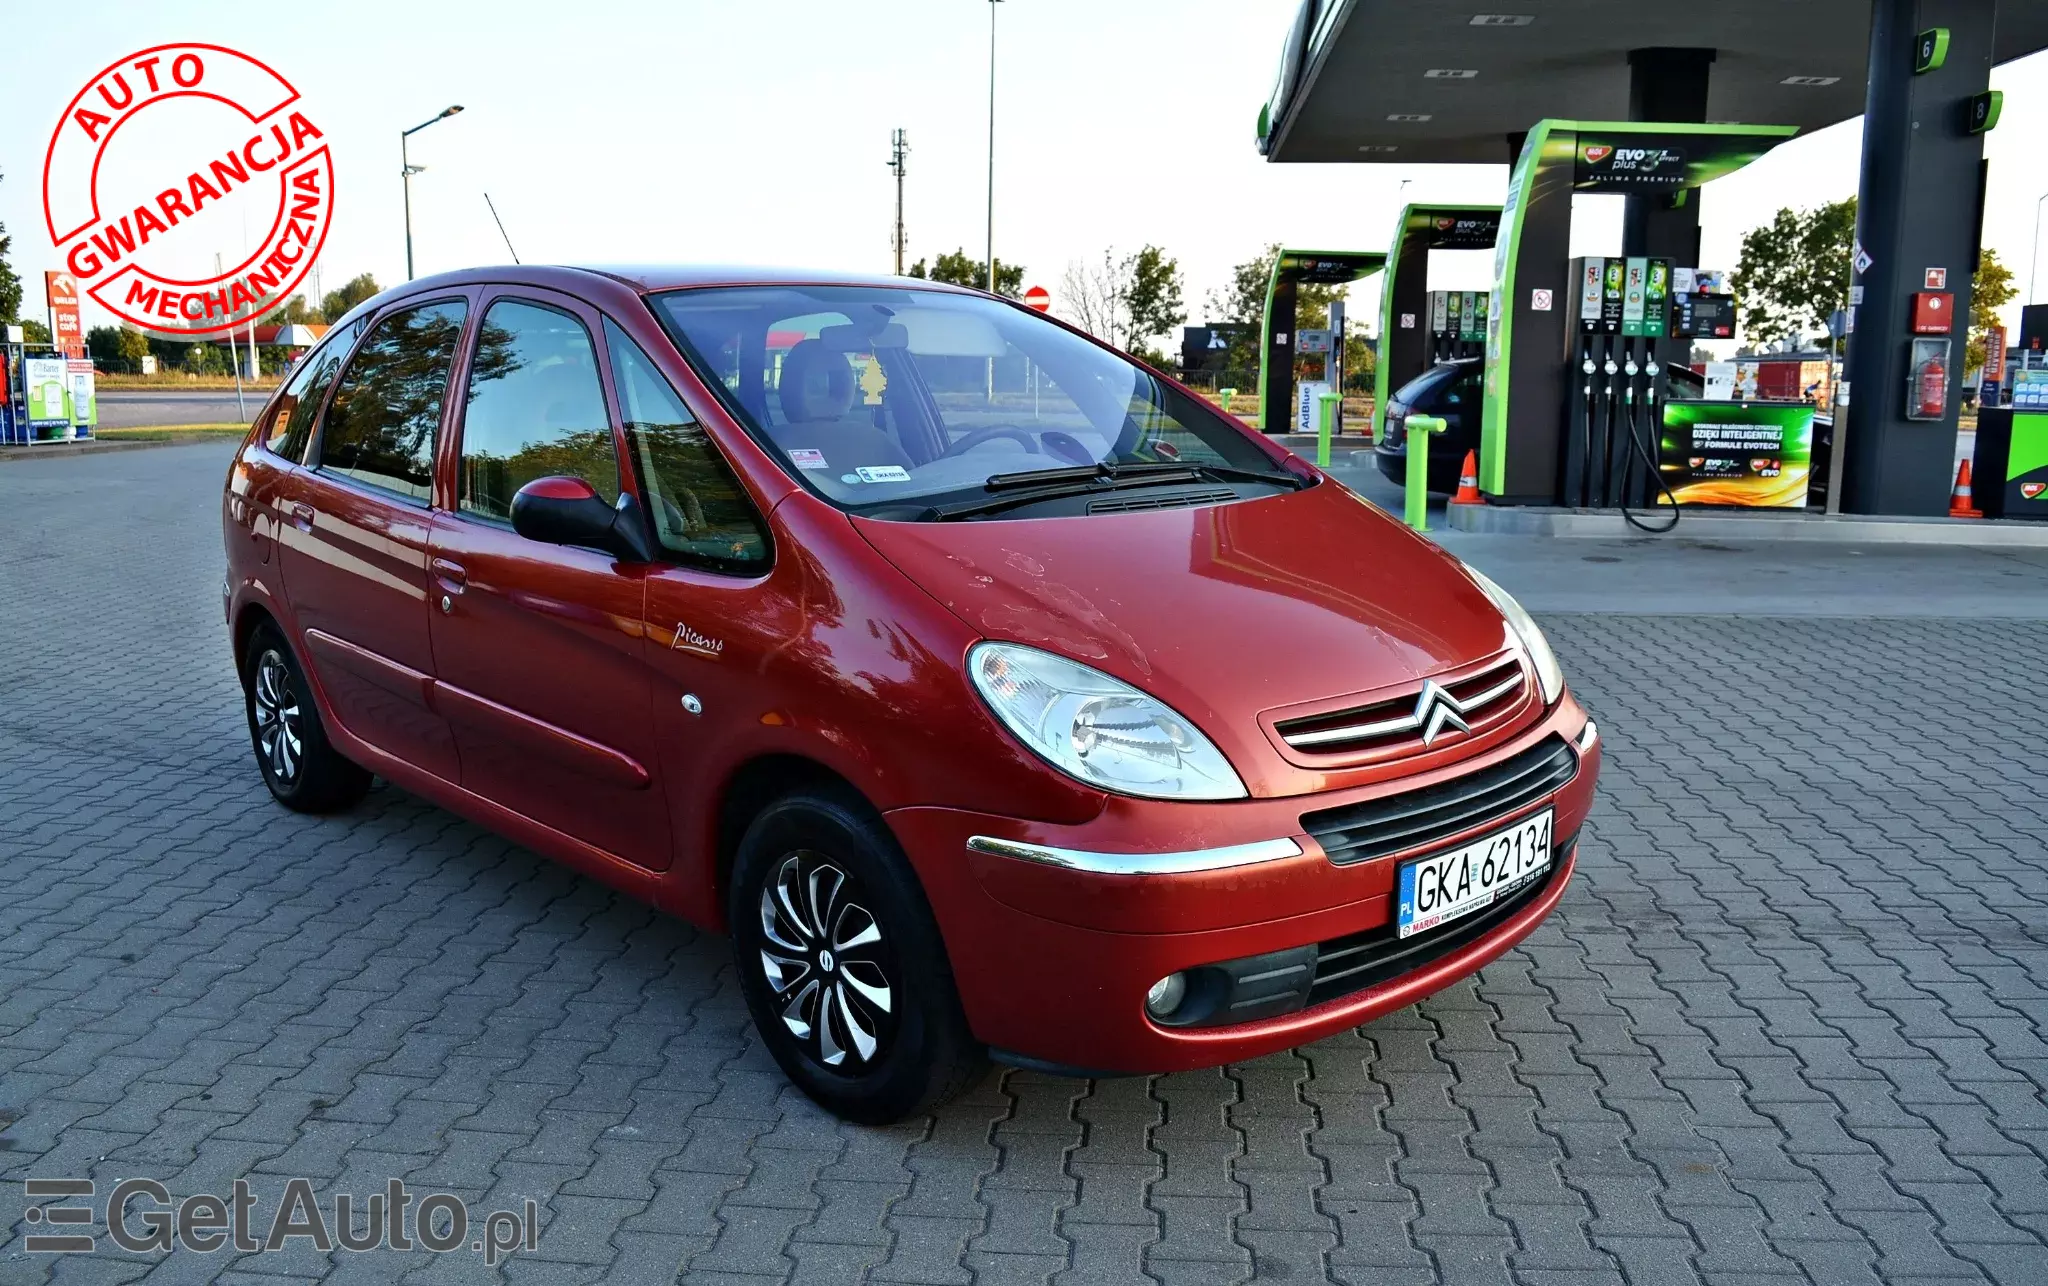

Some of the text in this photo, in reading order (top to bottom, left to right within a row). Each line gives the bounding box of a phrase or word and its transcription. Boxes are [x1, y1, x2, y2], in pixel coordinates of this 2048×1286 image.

[1923, 41, 1930, 58] 6
[1977, 103, 1985, 119] 8
[1615, 149, 1646, 161] EVO
[1612, 160, 1637, 170] plus
[59, 313, 77, 323] stop
[1301, 387, 1310, 429] AdBlue
[1692, 429, 1783, 441] DZIĘKI INTELIGENTNEJ
[1704, 441, 1780, 450] FORMULE EVOTECH
[1761, 469, 1780, 477] EVO
[671, 621, 723, 650] Picasso
[1417, 816, 1550, 912] GKA 62134
[1400, 902, 1413, 917] PL
[1412, 915, 1440, 933] MARKO
